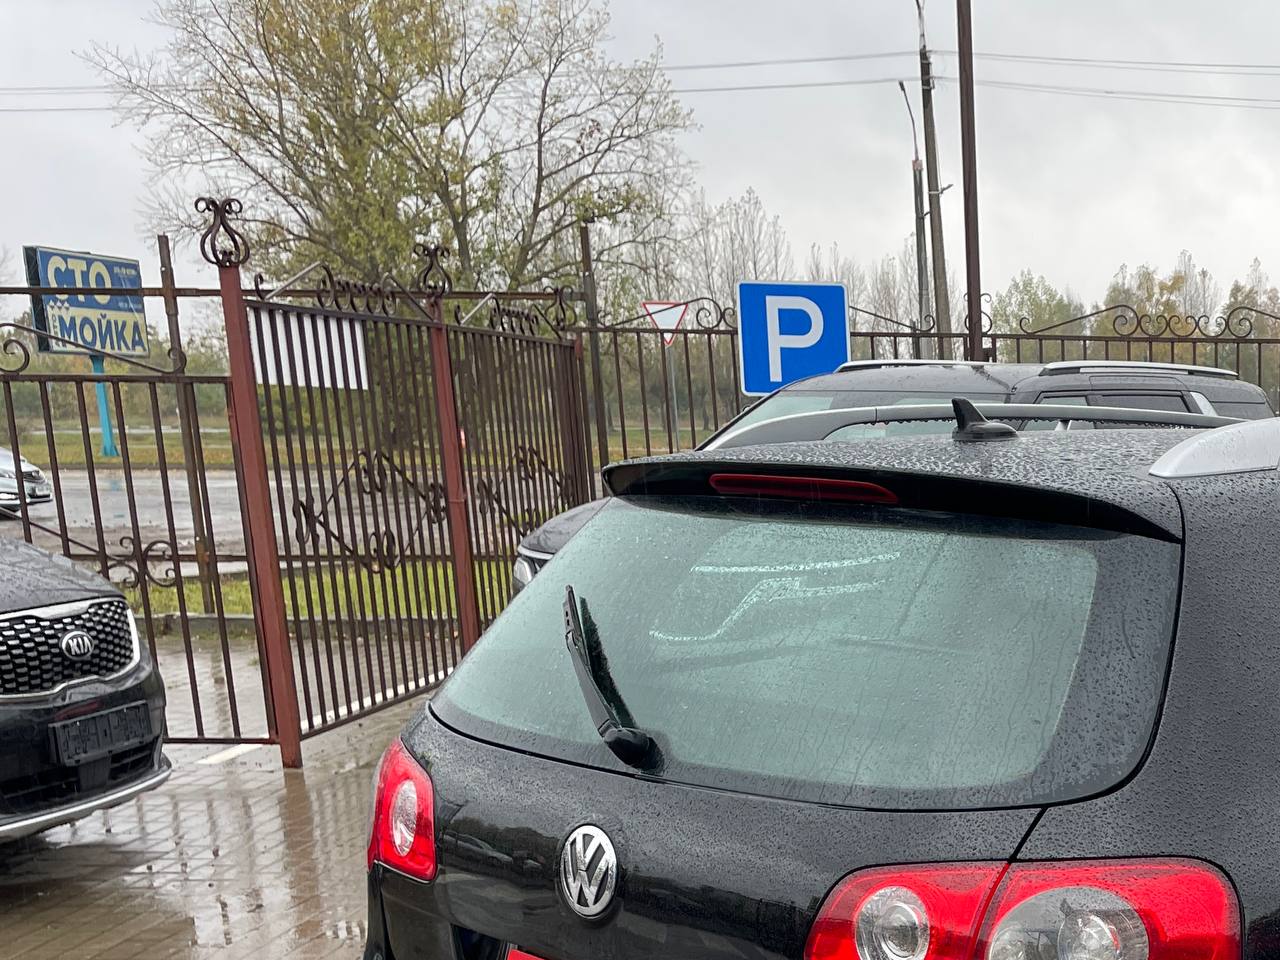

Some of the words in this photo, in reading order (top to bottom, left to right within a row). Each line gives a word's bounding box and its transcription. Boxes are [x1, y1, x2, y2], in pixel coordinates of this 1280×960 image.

[47, 255, 112, 304] СТО
[58, 313, 146, 351] МОЙКА
[765, 295, 824, 382] P
[69, 636, 93, 656] KIA
